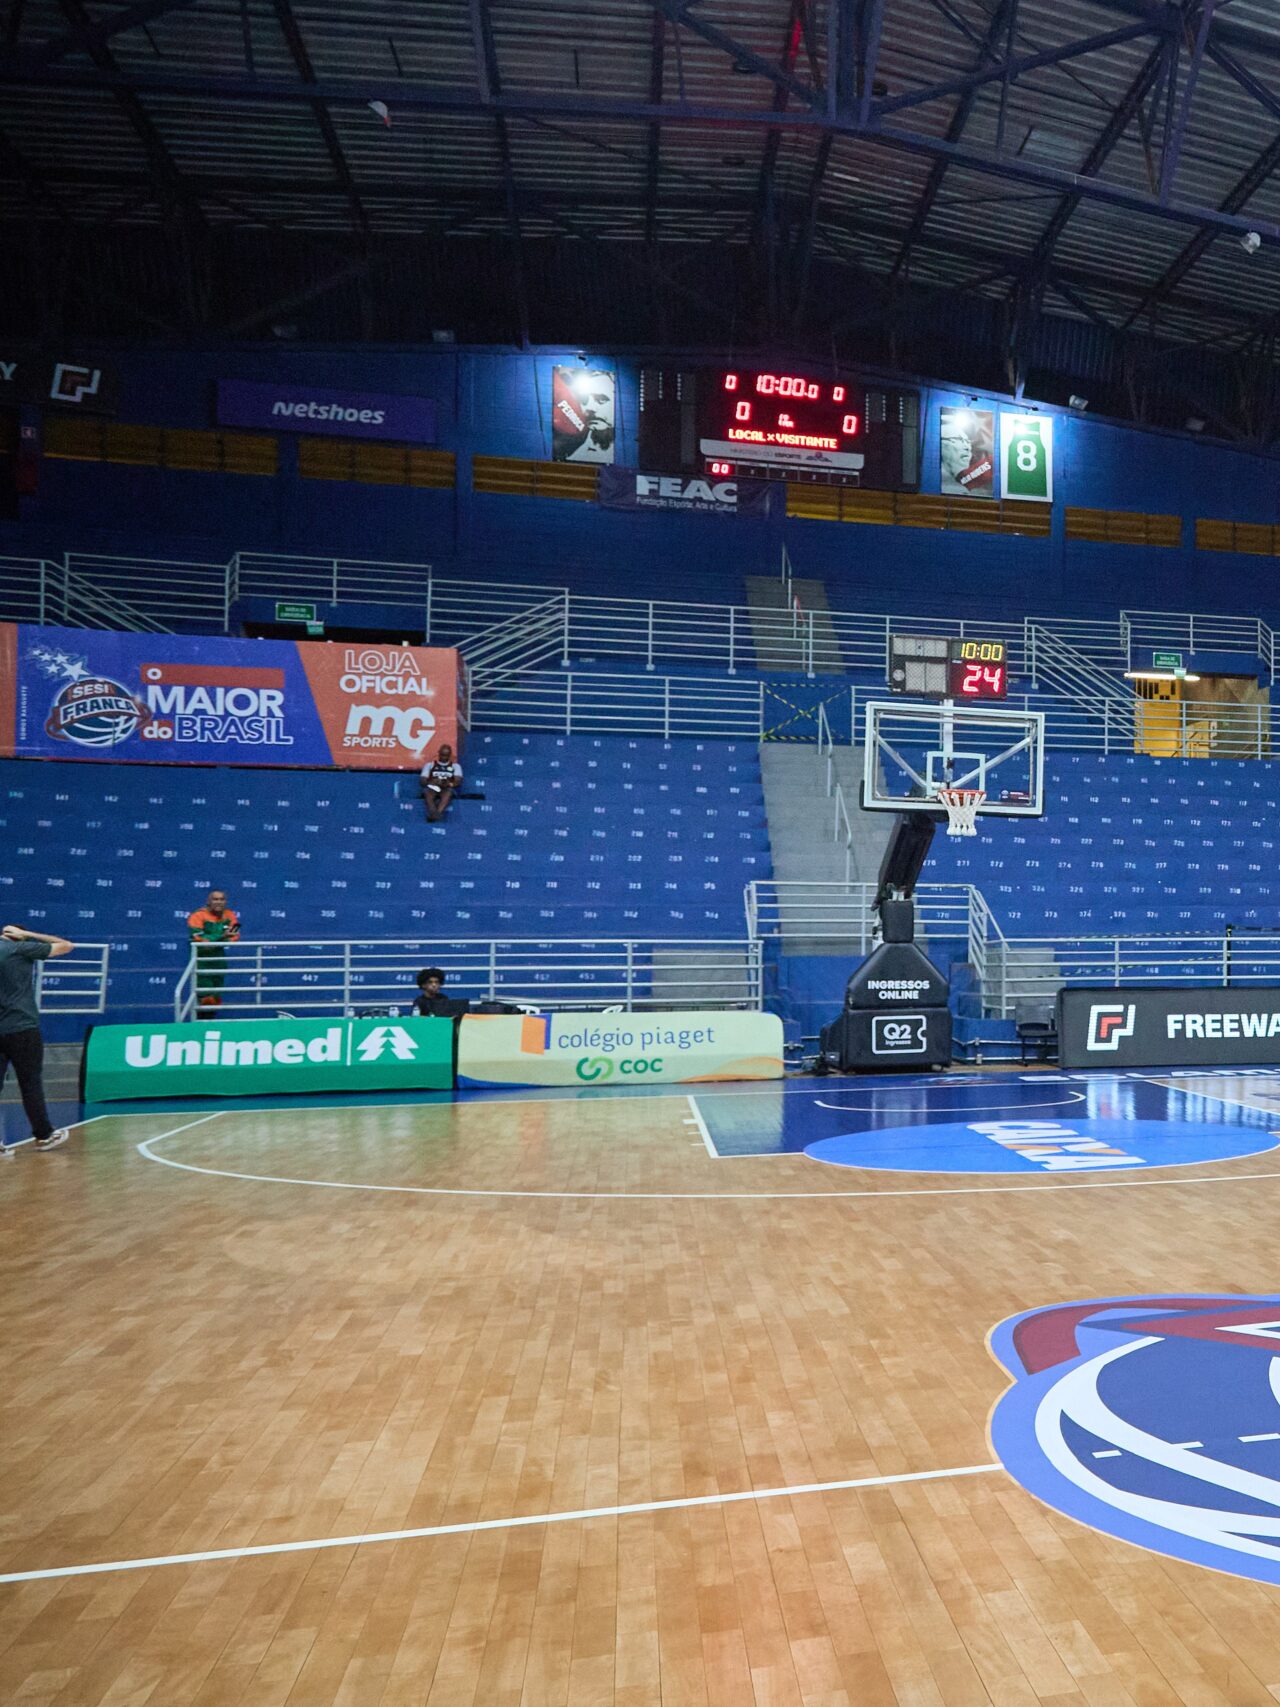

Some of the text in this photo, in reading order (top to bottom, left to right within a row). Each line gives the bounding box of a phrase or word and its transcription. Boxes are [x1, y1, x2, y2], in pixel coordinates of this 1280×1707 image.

[728, 428, 766, 443] LOCAL
[774, 433, 839, 449] VISITANTE
[1016, 439, 1038, 472] 8
[636, 475, 739, 504] FEAC
[344, 649, 421, 676] LOJA
[960, 642, 1003, 661] 10:00
[72, 683, 110, 699] SESI
[339, 675, 431, 697] OFICIAL
[962, 664, 1001, 693] 24
[60, 697, 140, 725] FRANCA
[147, 685, 285, 718] MAIOR
[143, 715, 294, 746] do BRASIL
[342, 735, 397, 749] SPORTS
[868, 980, 930, 990] INGRESSOS
[878, 990, 920, 1000] ONLINE
[558, 1027, 716, 1053] colégio piaget
[884, 1022, 912, 1041] Q2
[125, 1027, 342, 1067] Unimed
[966, 1121, 1148, 1171] CAIXA
